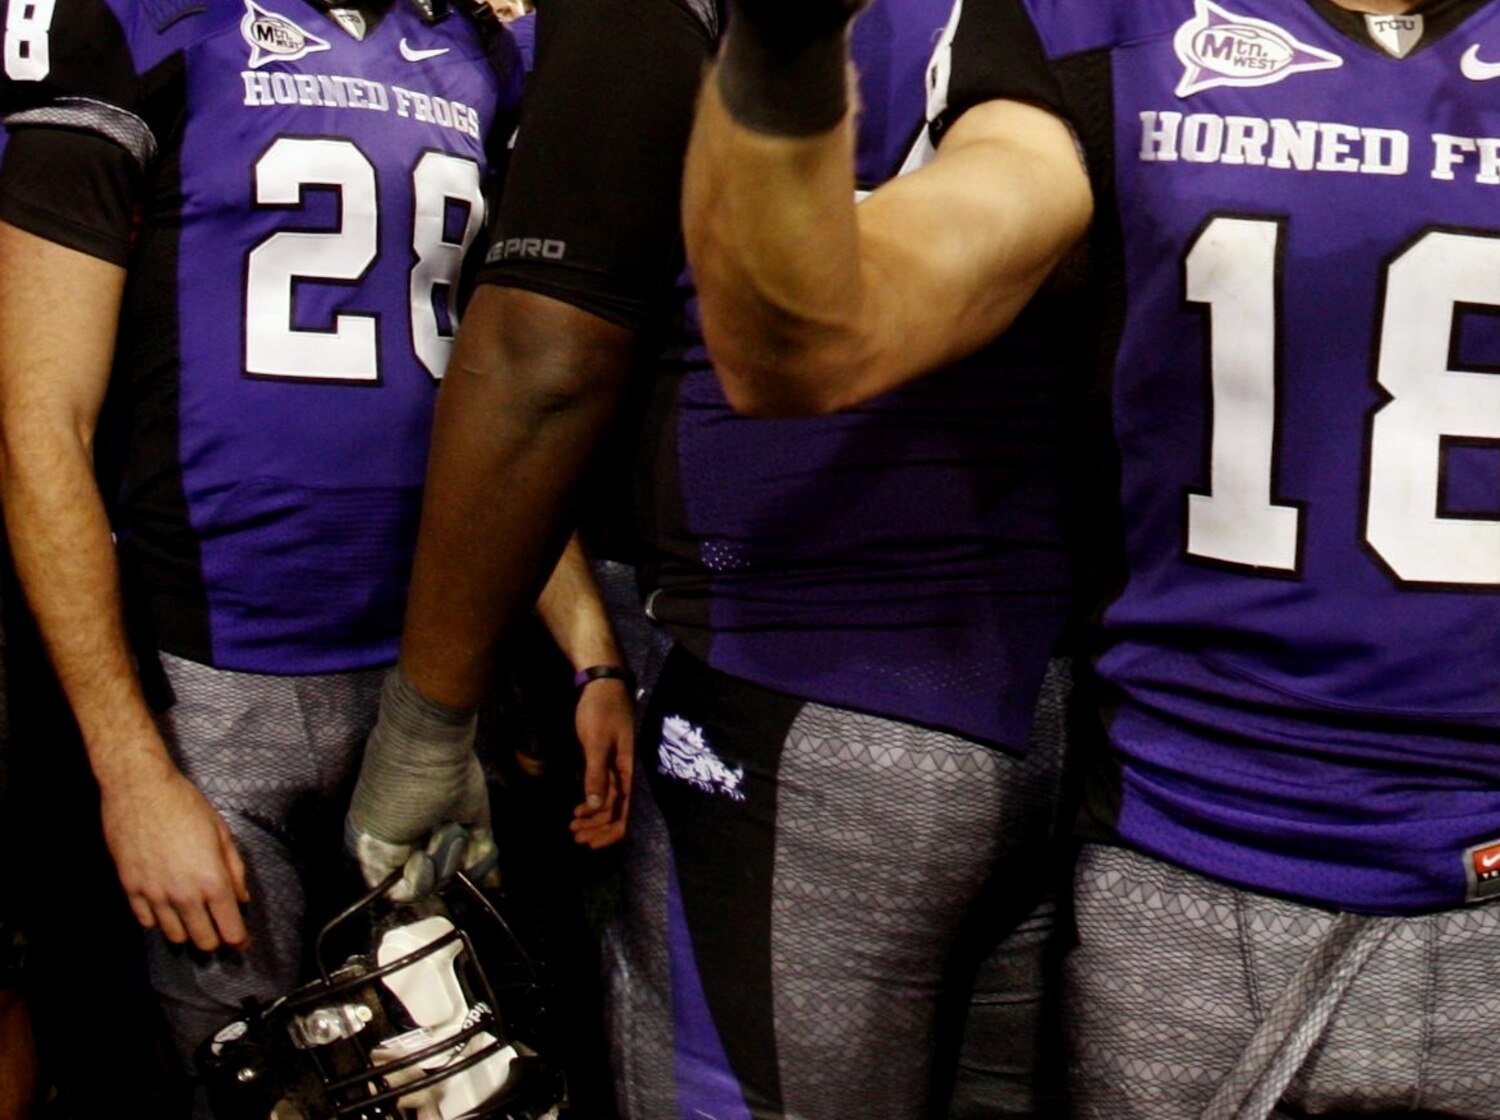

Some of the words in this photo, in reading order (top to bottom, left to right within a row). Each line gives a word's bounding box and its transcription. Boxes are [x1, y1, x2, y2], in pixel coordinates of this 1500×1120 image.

[1374, 19, 1417, 32] TCU
[1233, 58, 1279, 70] WEST
[241, 71, 390, 112] HORNED
[391, 86, 481, 140] FROGS
[1138, 110, 1410, 176] HORNED
[244, 136, 487, 381] 28
